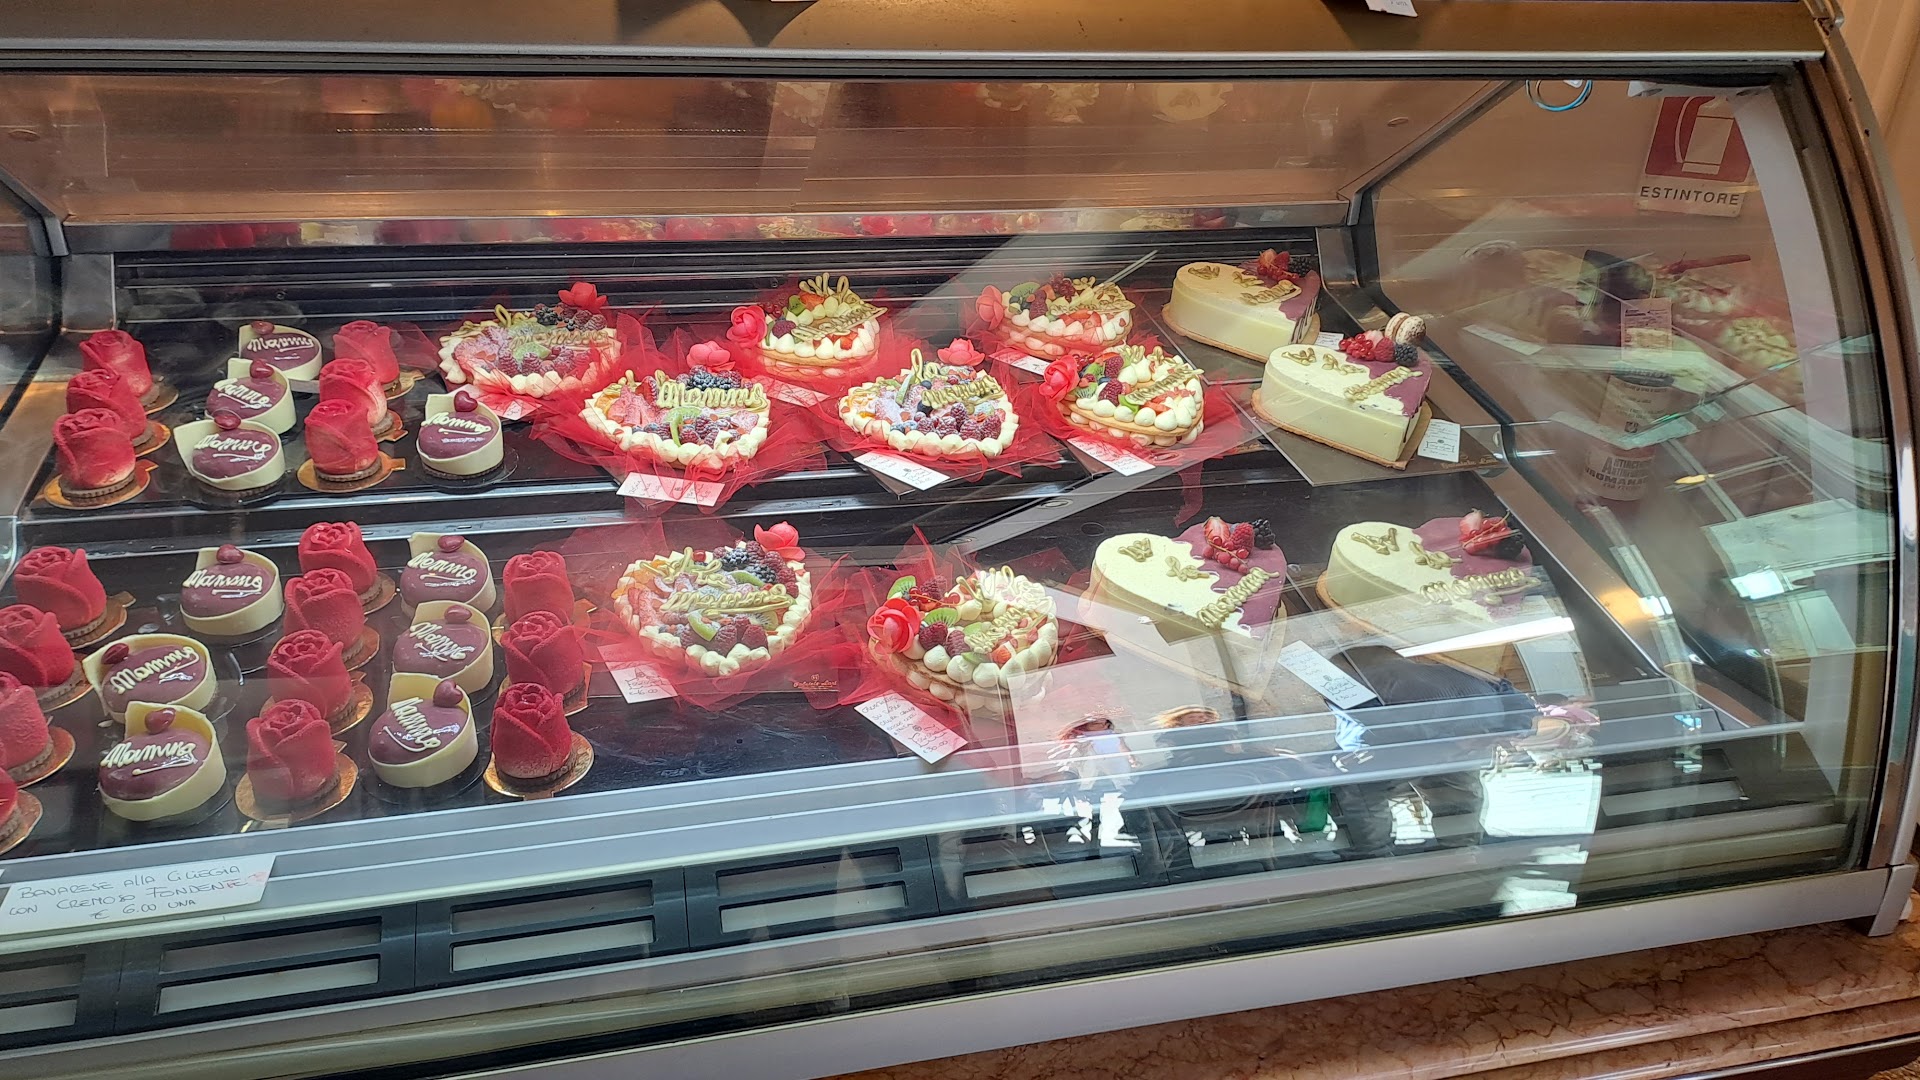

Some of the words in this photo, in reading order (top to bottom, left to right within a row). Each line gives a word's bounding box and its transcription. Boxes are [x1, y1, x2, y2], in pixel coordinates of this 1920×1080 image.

[1640, 186, 1740, 205] ESTINTORE
[9, 904, 38, 916] CON
[56, 894, 136, 909] CREMOSO
[146, 878, 249, 899] FONDENTE
[18, 881, 114, 899] BAVARESE
[122, 903, 157, 915] 6.00
[168, 899, 196, 909] UNA
